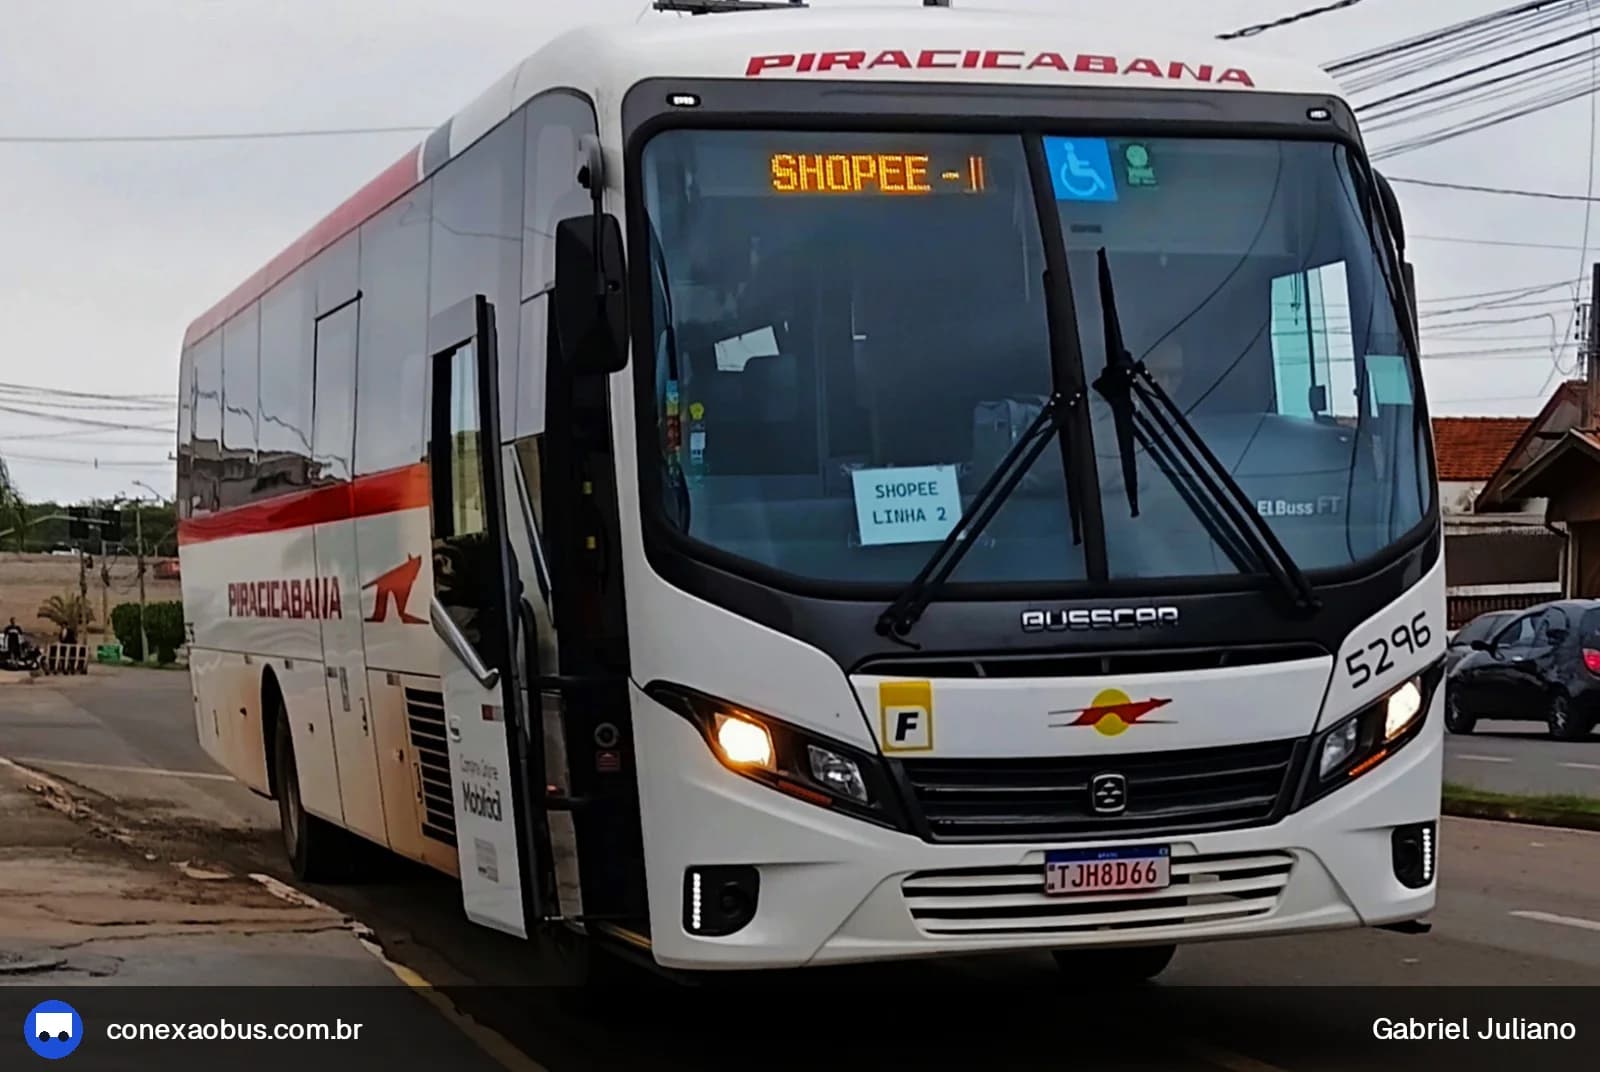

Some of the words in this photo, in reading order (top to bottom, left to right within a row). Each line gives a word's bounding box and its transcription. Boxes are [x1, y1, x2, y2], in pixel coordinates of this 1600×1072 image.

[746, 49, 1255, 88] PIRACICABANA
[771, 154, 931, 192] SHOPEE
[875, 481, 939, 499] SHOPEE
[873, 508, 926, 524] LINHA
[936, 506, 947, 521] 2
[228, 576, 342, 620] PIRACICABANA
[1022, 607, 1178, 630] BUSSCAR
[1346, 611, 1431, 689] 5296
[896, 712, 919, 741] F
[1058, 861, 1157, 888] TJH8D66
